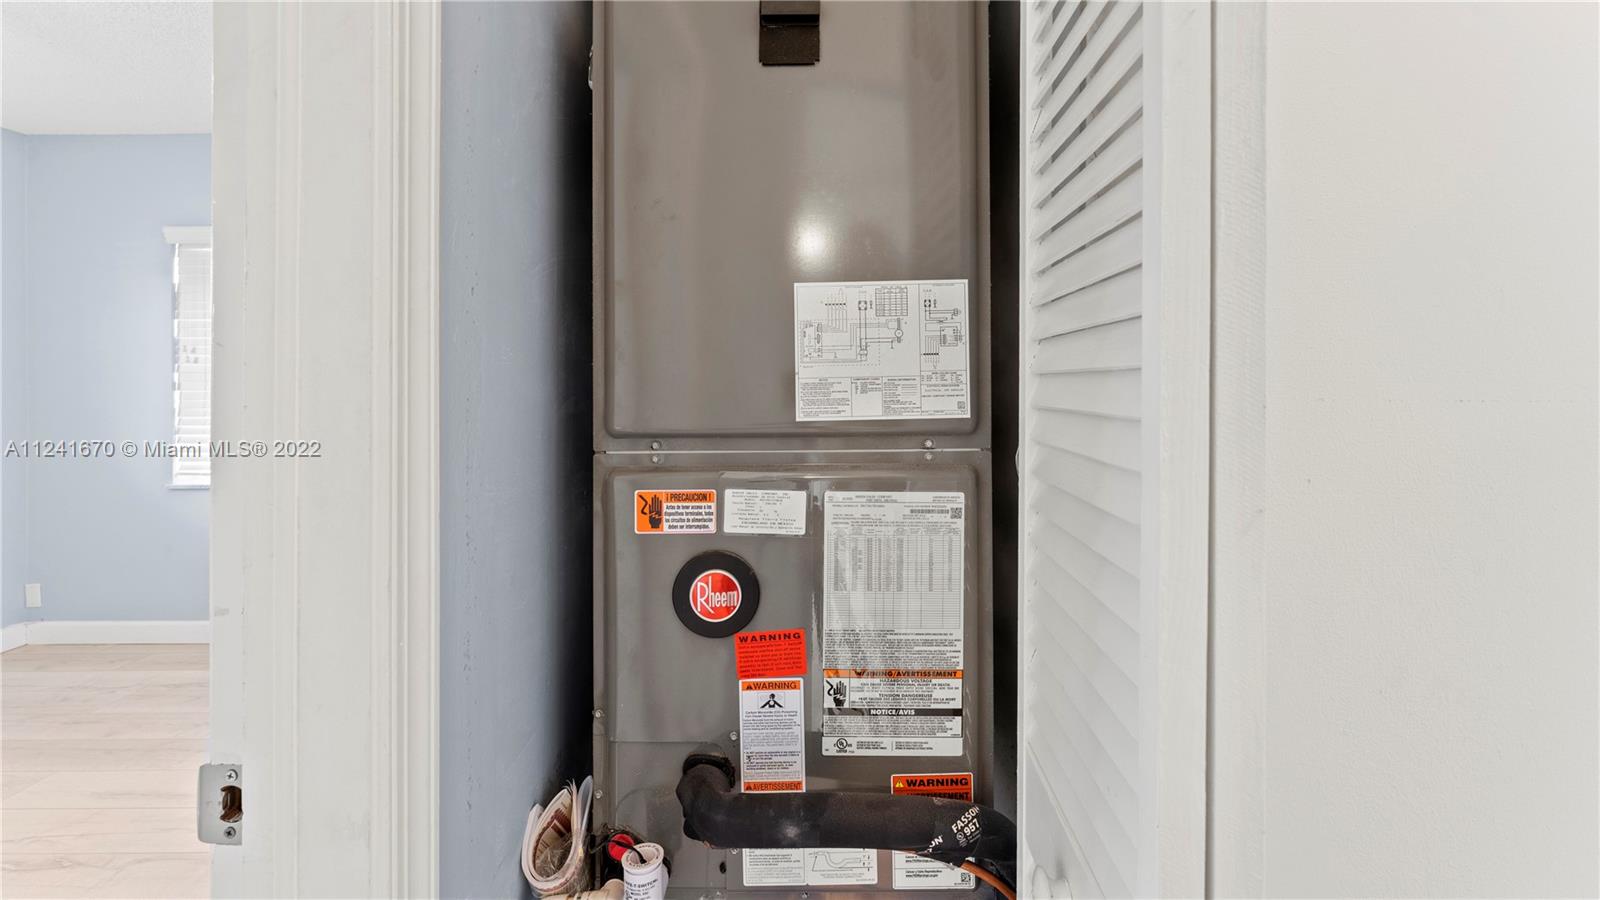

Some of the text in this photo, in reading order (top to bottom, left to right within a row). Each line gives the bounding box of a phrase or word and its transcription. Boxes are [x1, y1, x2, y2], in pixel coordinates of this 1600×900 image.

[670, 493, 707, 502] PRECAUCION
[697, 576, 737, 614] Rheem
[739, 632, 800, 643] WARNING
[753, 682, 796, 690] WARNING
[906, 778, 968, 787] WARNING
[952, 805, 980, 833] FASSON
[964, 818, 980, 836] 957
